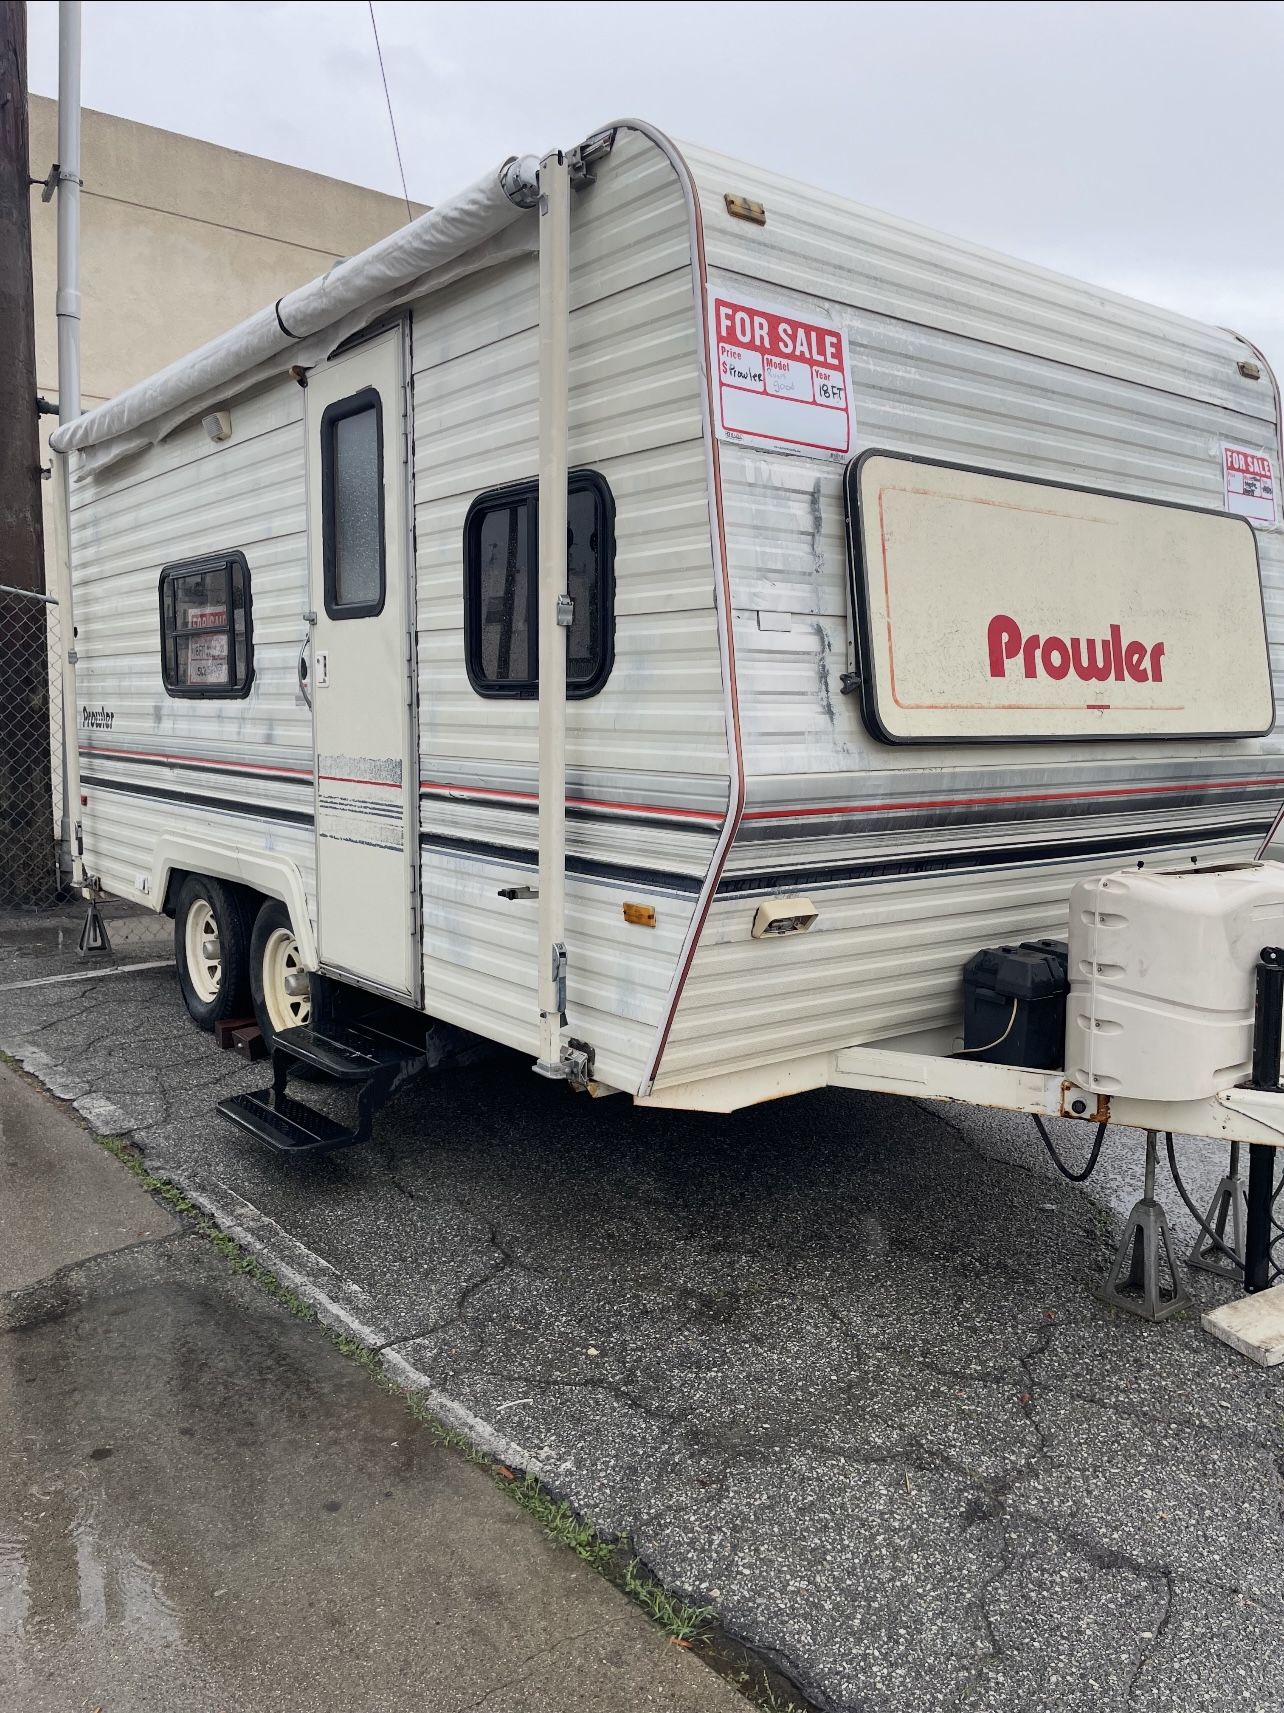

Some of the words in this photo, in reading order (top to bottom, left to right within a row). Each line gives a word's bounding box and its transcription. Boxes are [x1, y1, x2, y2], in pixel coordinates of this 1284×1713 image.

[719, 305, 770, 349] FOR
[778, 322, 840, 366] SALE
[720, 345, 742, 360] Price
[721, 360, 729, 375] $
[765, 357, 790, 372] Model
[814, 368, 831, 381] Year
[1226, 451, 1246, 471] FOR
[1247, 457, 1271, 476] SALE
[987, 614, 1165, 683] Prowler
[83, 705, 114, 729] Prowler
